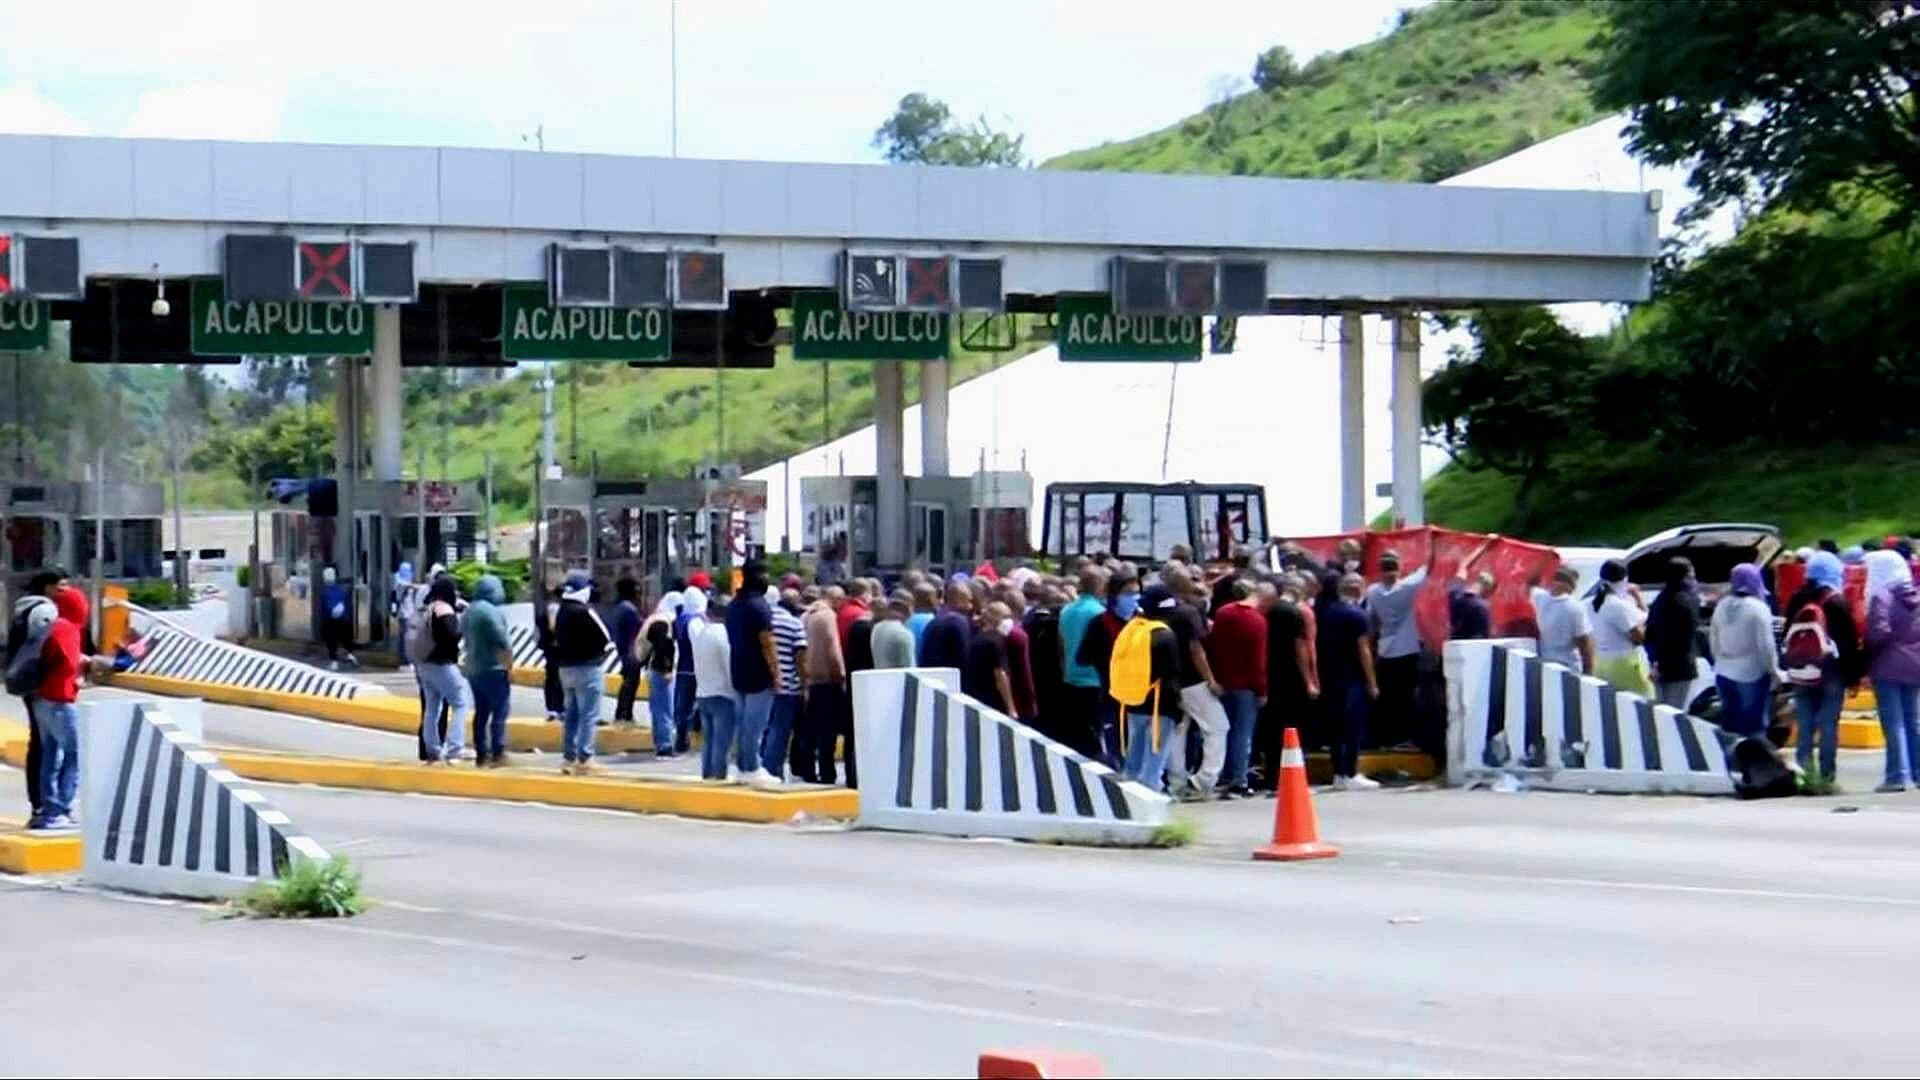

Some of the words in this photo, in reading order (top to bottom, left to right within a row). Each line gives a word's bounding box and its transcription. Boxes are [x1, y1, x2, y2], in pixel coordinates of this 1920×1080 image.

[204, 300, 364, 335] ACAPULCO
[513, 307, 662, 340] ACAPULCO
[802, 309, 941, 341] ACAPULCO
[1067, 313, 1196, 344] ACAPULCO
